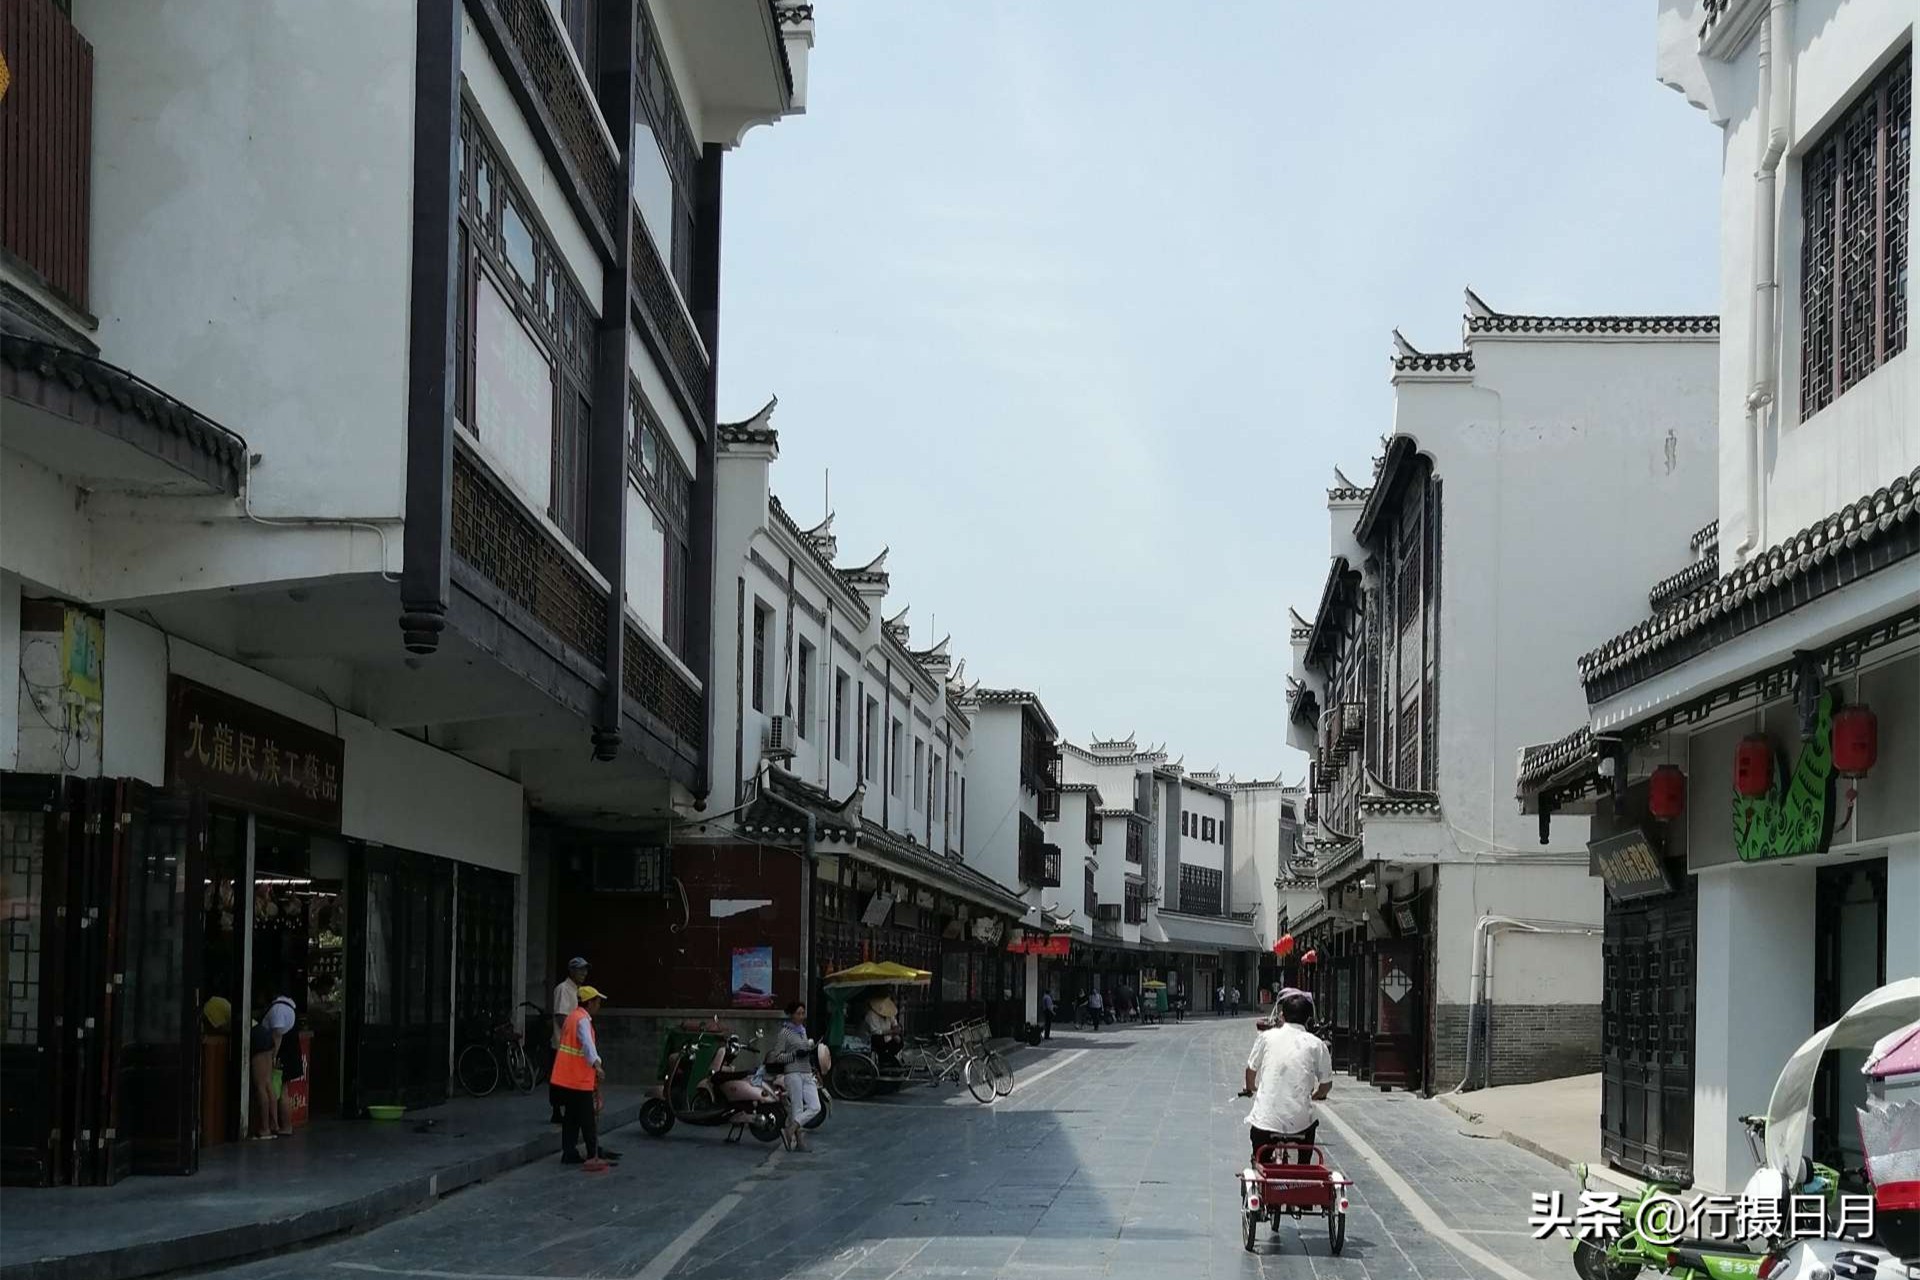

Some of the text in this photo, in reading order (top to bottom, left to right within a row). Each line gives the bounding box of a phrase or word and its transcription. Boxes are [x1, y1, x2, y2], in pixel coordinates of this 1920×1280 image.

[185, 714, 337, 802] 九龍民族工藝品
